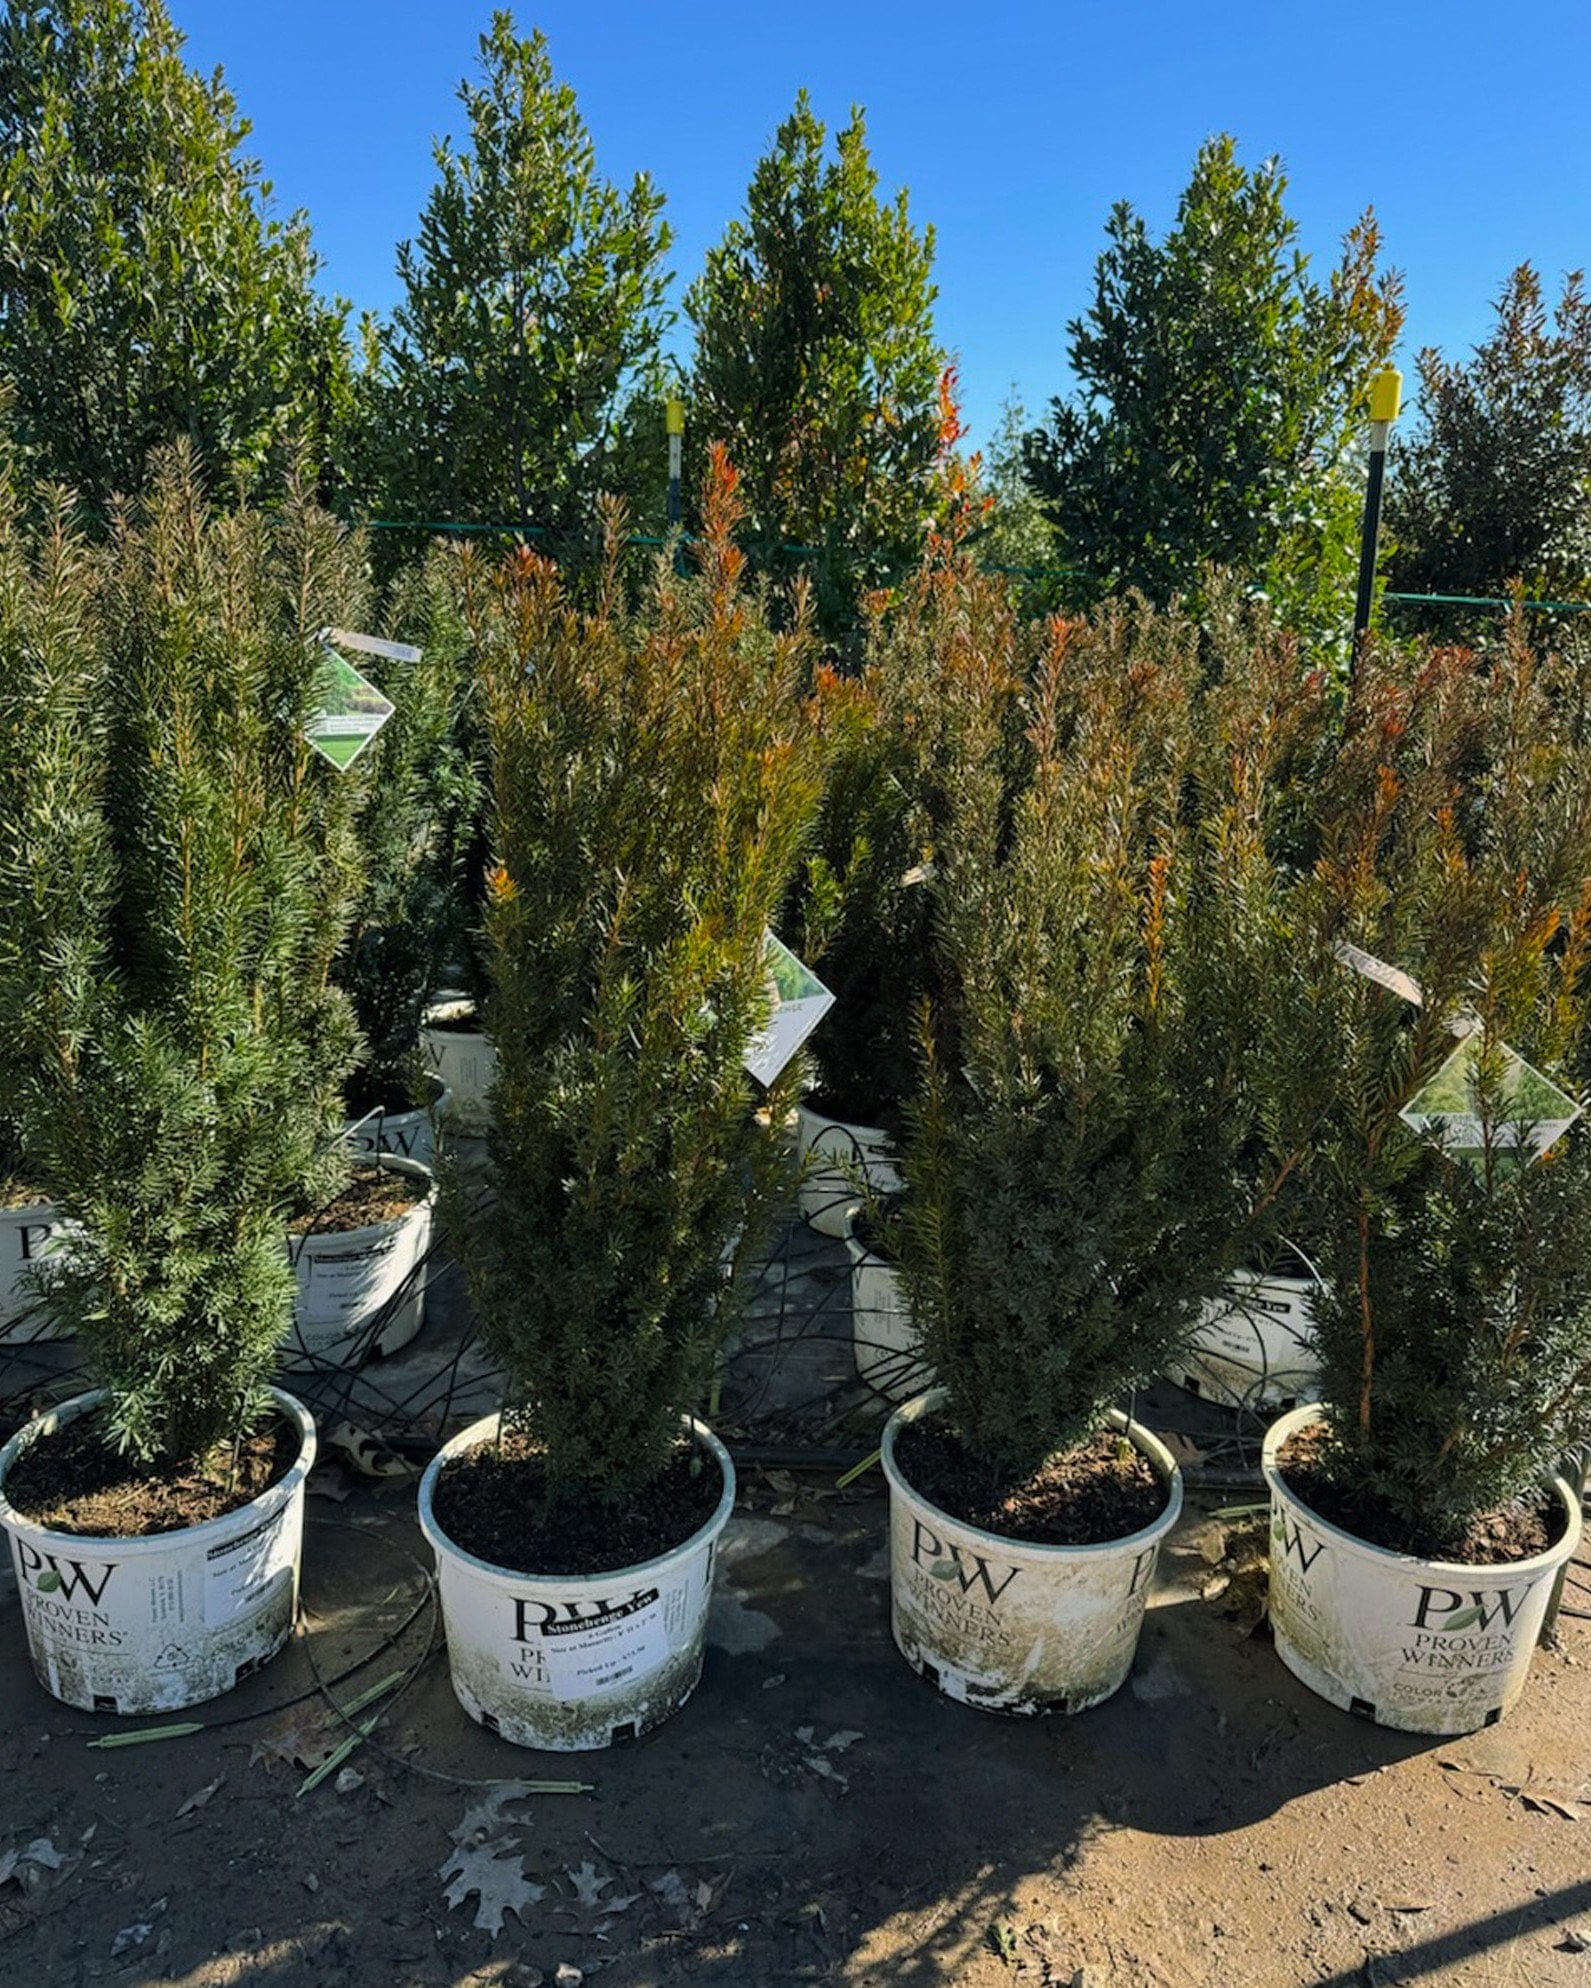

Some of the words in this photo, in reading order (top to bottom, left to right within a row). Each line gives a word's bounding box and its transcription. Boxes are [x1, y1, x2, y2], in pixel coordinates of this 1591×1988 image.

[16, 1534, 120, 1607] PW
[910, 1514, 1023, 1604] PW
[546, 1610, 625, 1634] Stonehenge
[626, 1594, 653, 1612] Yew
[1406, 1581, 1536, 1632] PW
[1402, 1647, 1514, 1668] WINNERS
[1415, 1633, 1515, 1653] PROVEN
